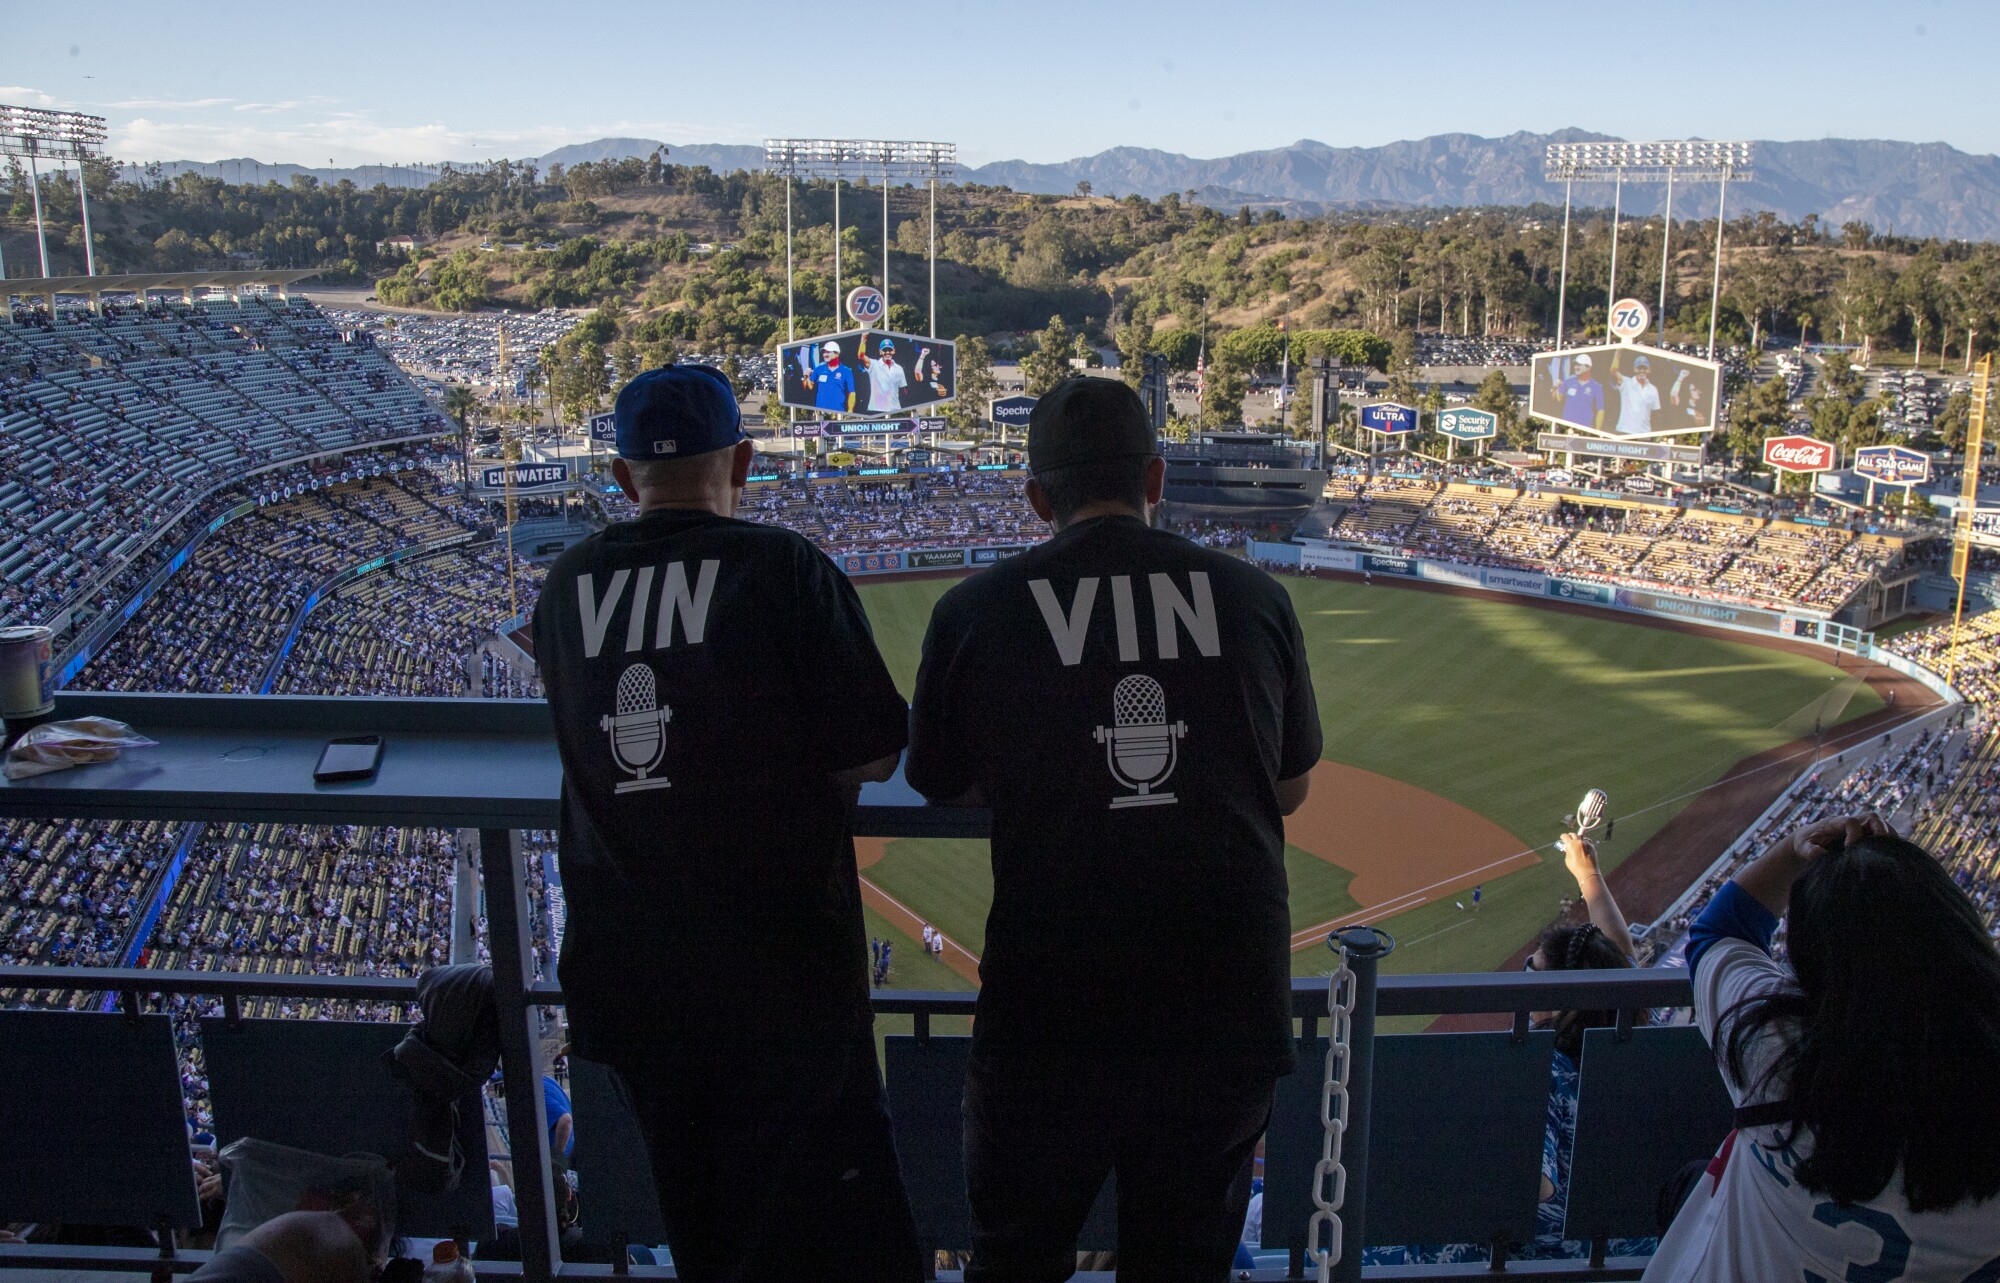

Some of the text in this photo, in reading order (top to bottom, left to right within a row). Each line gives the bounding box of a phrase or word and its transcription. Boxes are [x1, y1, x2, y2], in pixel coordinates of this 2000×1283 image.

[854, 294, 882, 316] 76
[1616, 308, 1641, 329] 76
[996, 405, 1031, 417] Spectru
[1373, 411, 1405, 422] ULTRA
[597, 418, 616, 432] blu
[1459, 415, 1490, 426] Security
[841, 423, 900, 432] UNION NIGHT
[1459, 424, 1486, 433] Benefit
[1586, 442, 1649, 455] UNION NIGHT
[1859, 457, 1924, 473] ALL STAR GAME
[489, 468, 562, 485] CUTWATER
[849, 560, 859, 568] 76
[868, 559, 878, 567] 76
[887, 558, 897, 566] 76
[1372, 558, 1407, 568] Spectrum
[1488, 575, 1543, 591] smartwater
[1573, 583, 1599, 594] Security
[577, 560, 720, 658] VIN
[1655, 599, 1738, 620] UNION NIGHT
[1027, 571, 1221, 666] VIN
